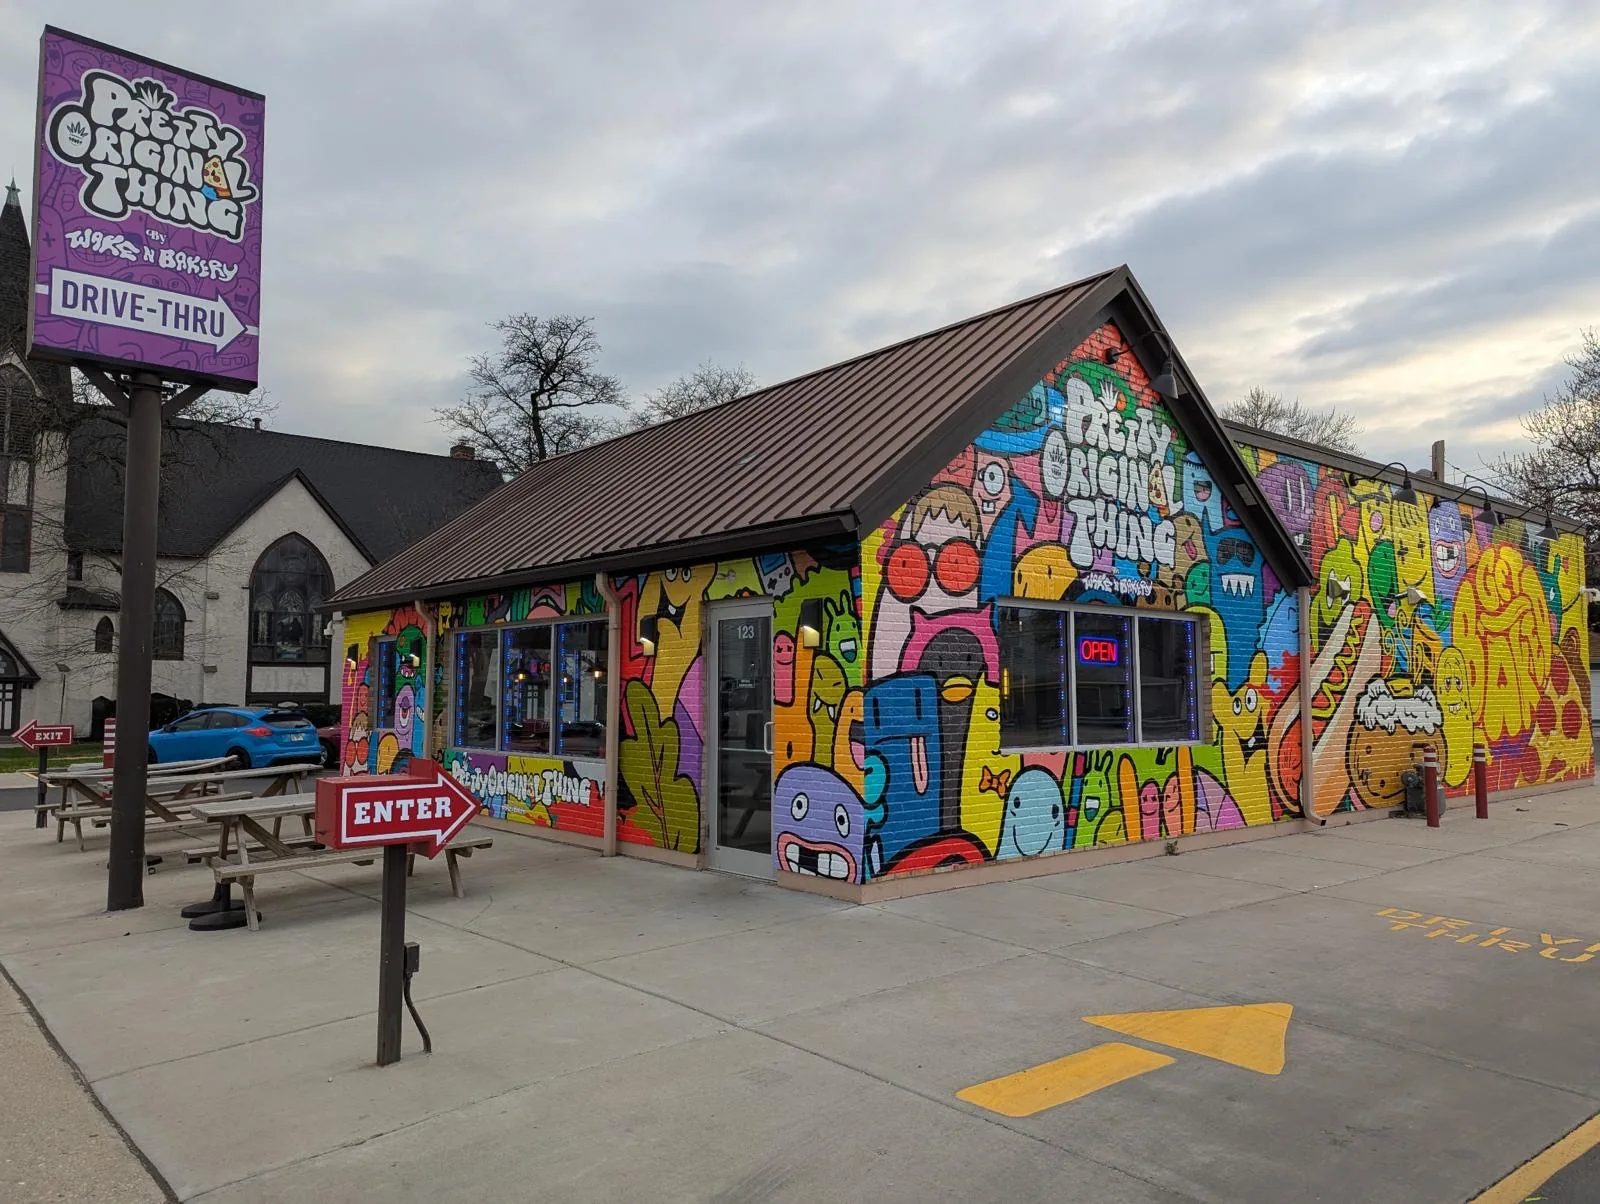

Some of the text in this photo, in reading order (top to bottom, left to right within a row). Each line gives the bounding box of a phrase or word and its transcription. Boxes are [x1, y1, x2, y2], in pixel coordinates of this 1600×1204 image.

[91, 78, 238, 160] PRETTY
[91, 164, 239, 236] THING
[65, 229, 239, 281] WAKE N BAKERY
[62, 279, 225, 338] DRIVE-THRU
[1066, 377, 1171, 465] PRETTY
[1068, 499, 1176, 568] THING
[1476, 546, 1524, 611] GET
[737, 625, 755, 639] 123
[1081, 640, 1117, 662] OPEN
[35, 731, 64, 741] EXIT
[354, 796, 452, 825] ENTER
[542, 770, 592, 807] THING
[1390, 920, 1595, 962] THRU
